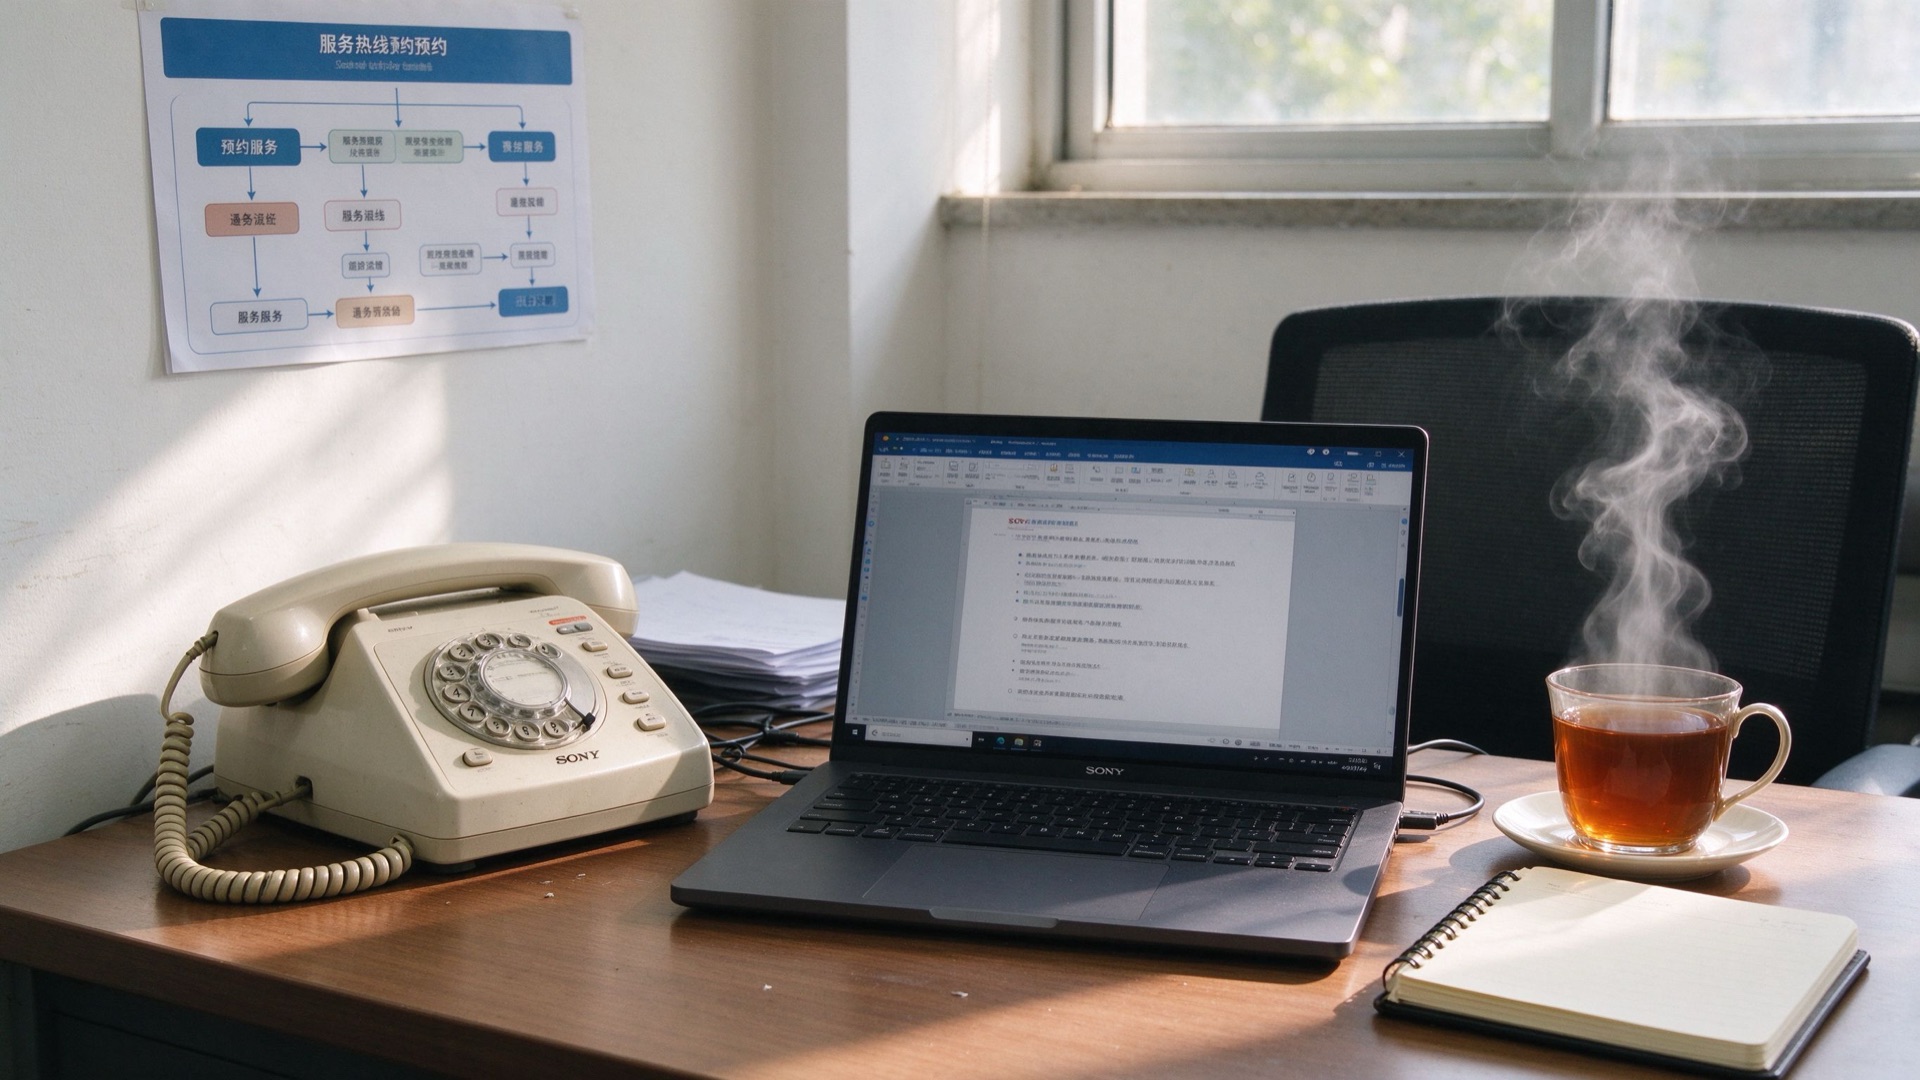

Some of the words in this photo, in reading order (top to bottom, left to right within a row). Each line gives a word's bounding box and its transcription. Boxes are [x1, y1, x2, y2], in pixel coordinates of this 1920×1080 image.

[221, 138, 278, 155] 预约服务
[237, 309, 283, 325] 服务服务
[555, 750, 600, 765] SONY
[1085, 766, 1125, 776] SONY
